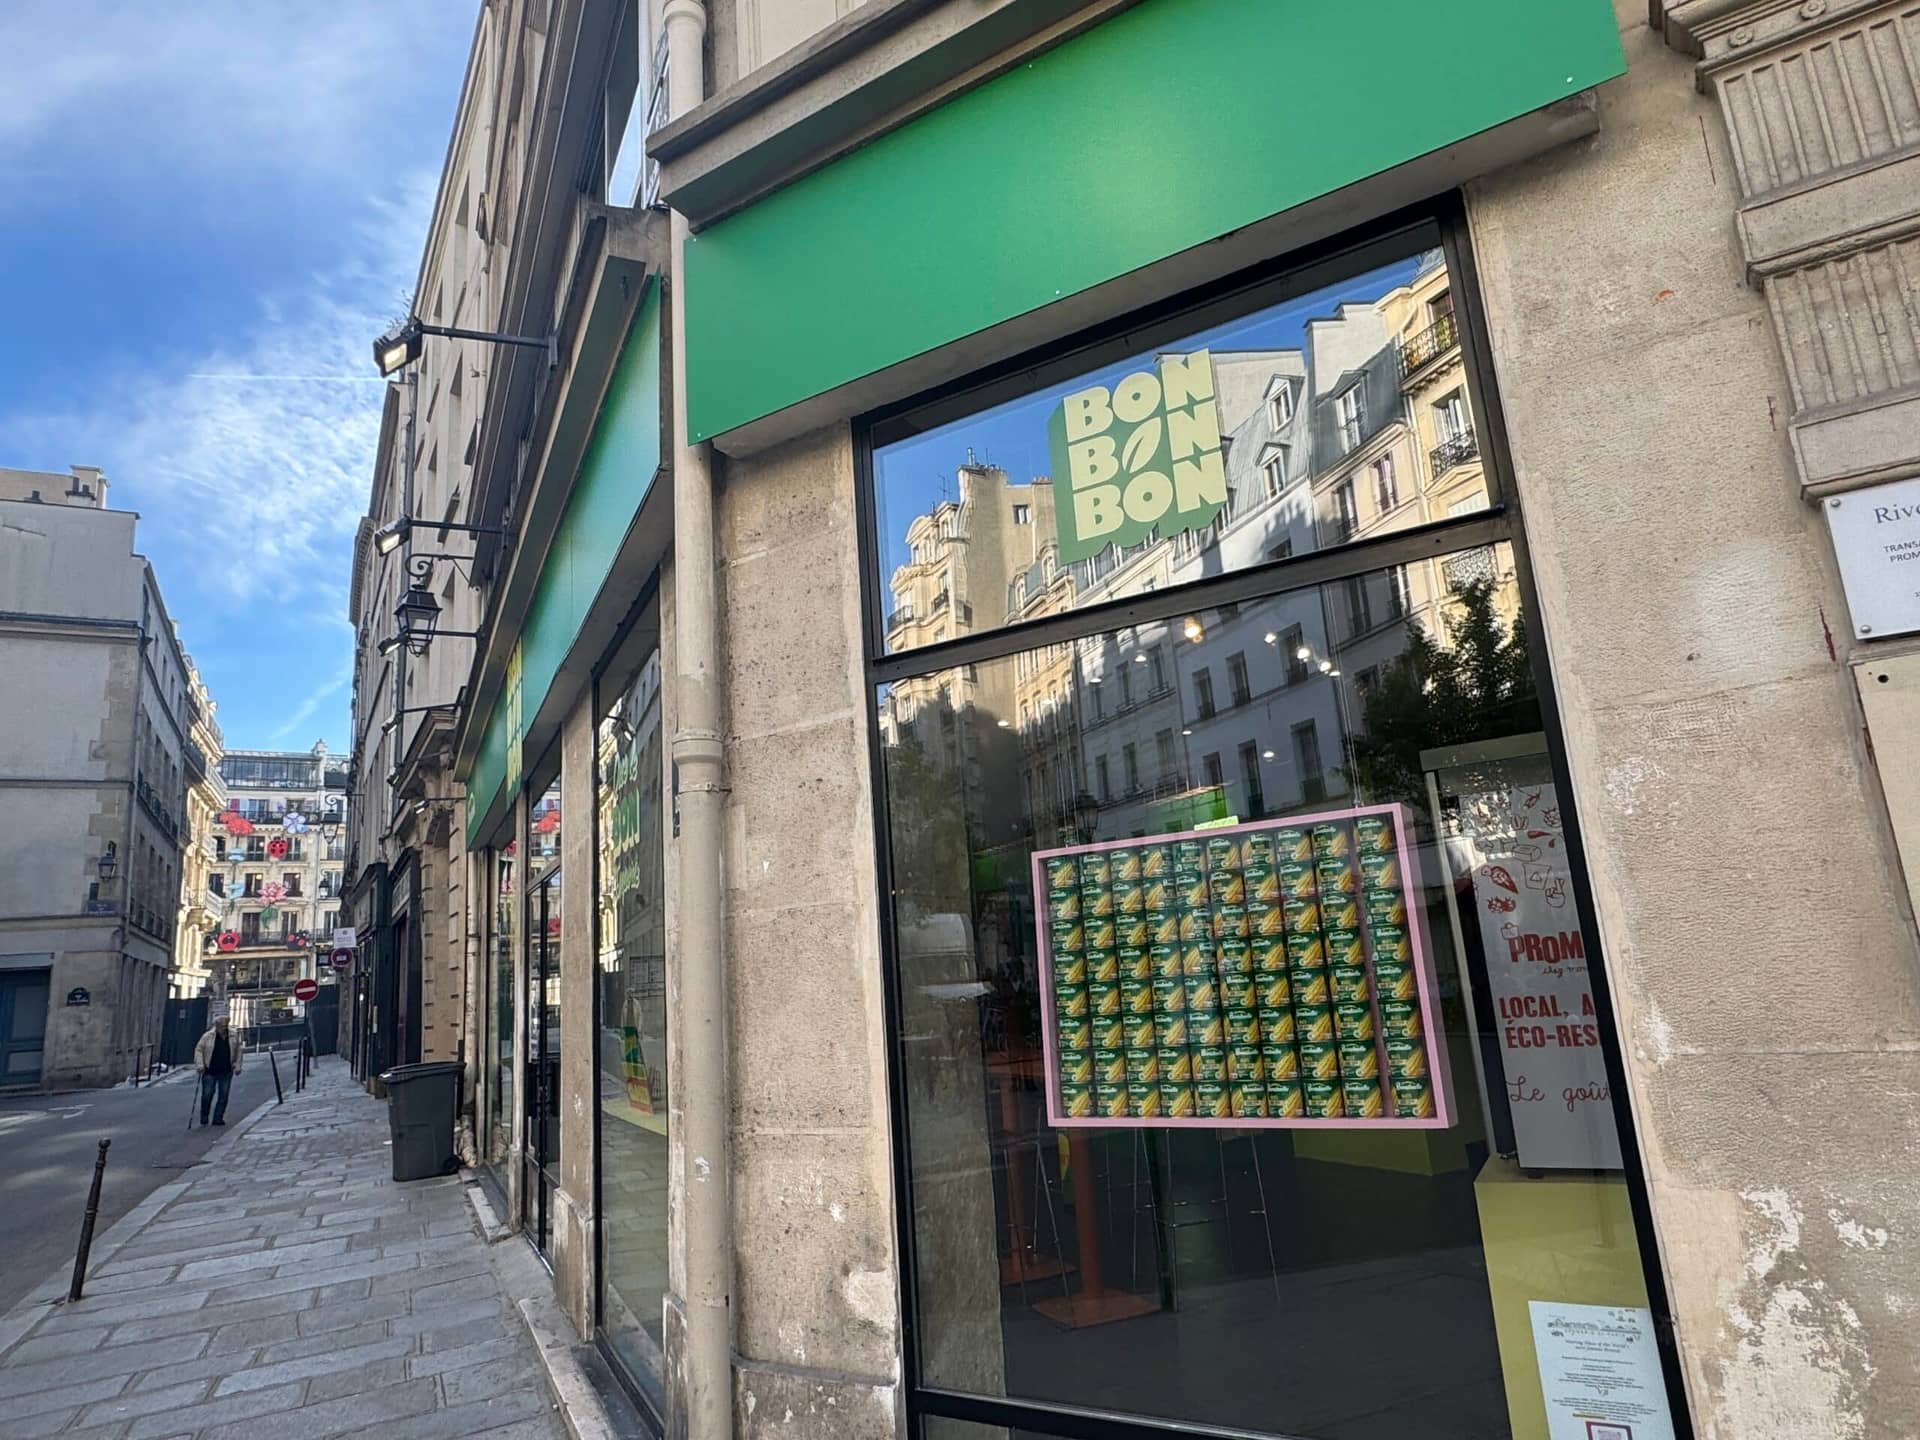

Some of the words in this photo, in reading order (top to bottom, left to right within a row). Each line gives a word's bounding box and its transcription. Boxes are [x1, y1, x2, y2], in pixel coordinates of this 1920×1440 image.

[1063, 347, 1215, 443] BON
[1072, 450, 1228, 541] BON
[1508, 930, 1585, 964] PROM
[1499, 994, 1569, 1020] LOCAL,
[1506, 1075, 1545, 1102] Le
